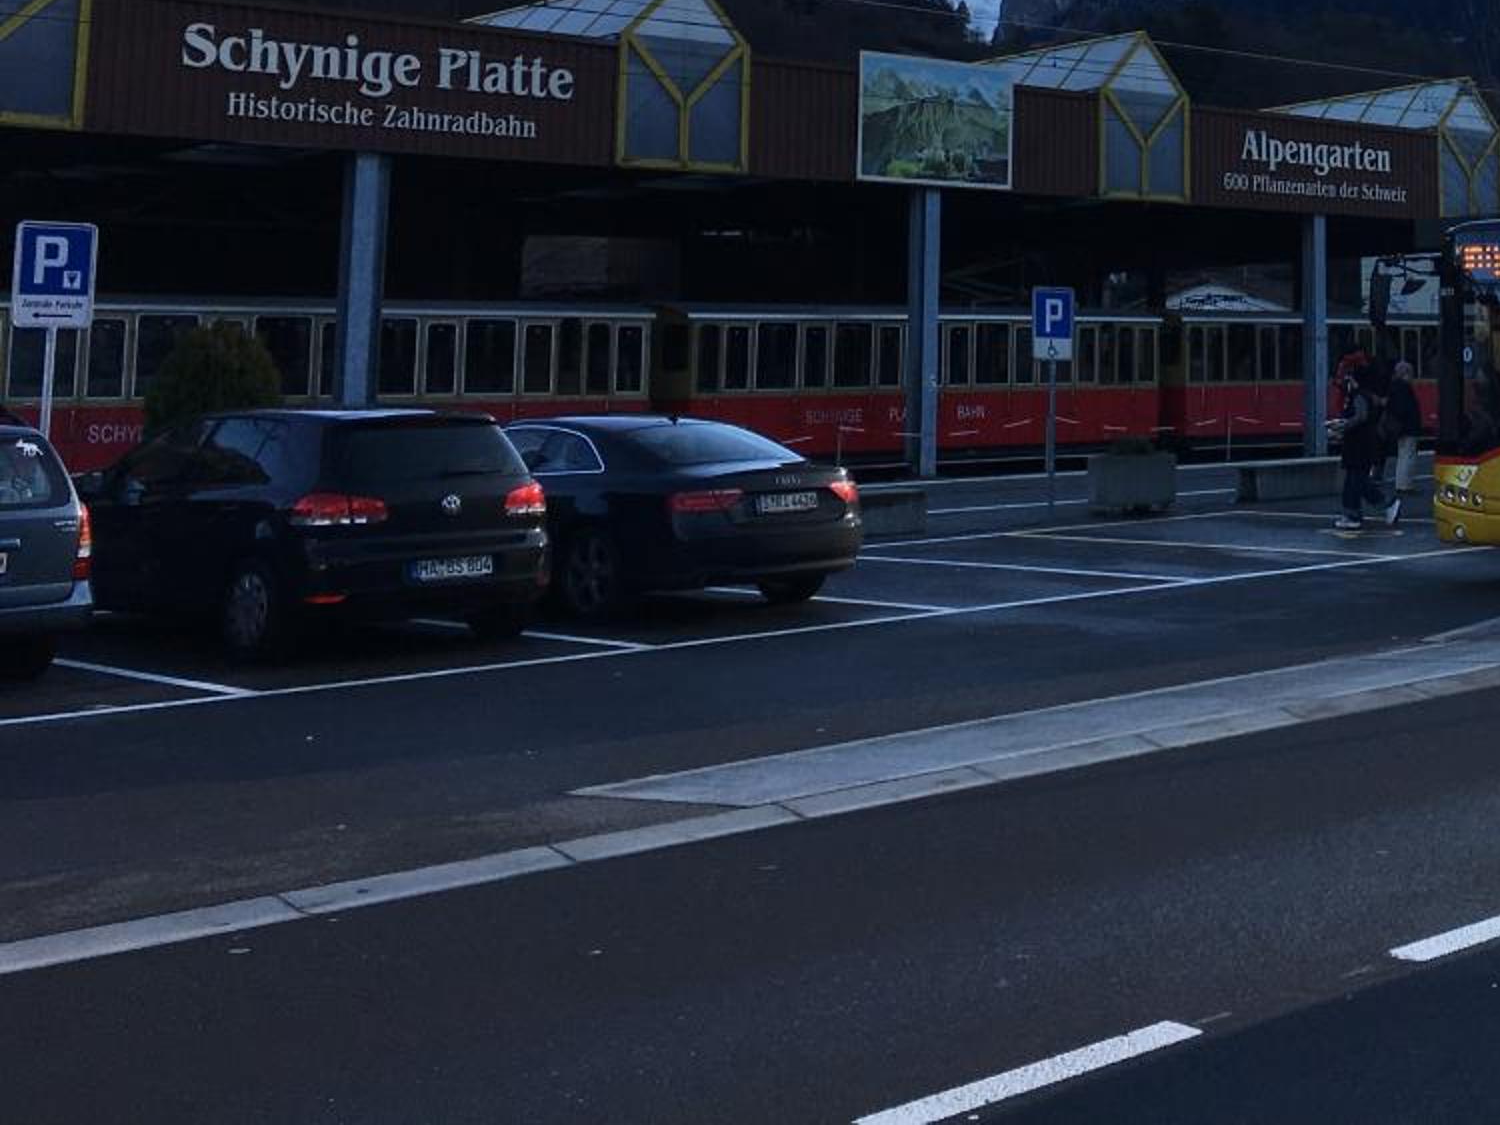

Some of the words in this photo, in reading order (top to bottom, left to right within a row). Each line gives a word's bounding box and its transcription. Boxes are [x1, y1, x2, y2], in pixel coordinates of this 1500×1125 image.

[182, 22, 421, 98] Schynige
[437, 47, 574, 100] Platte
[227, 91, 374, 127] Historische
[383, 103, 537, 139] Zahnradbahn
[1241, 130, 1391, 176] Alpengarten
[1223, 172, 1249, 191] 600
[1252, 174, 1336, 198] Pflanzenarten
[1339, 184, 1358, 199] der
[1361, 183, 1408, 203] Schweiz
[33, 235, 69, 284] P
[1045, 298, 1063, 333] P
